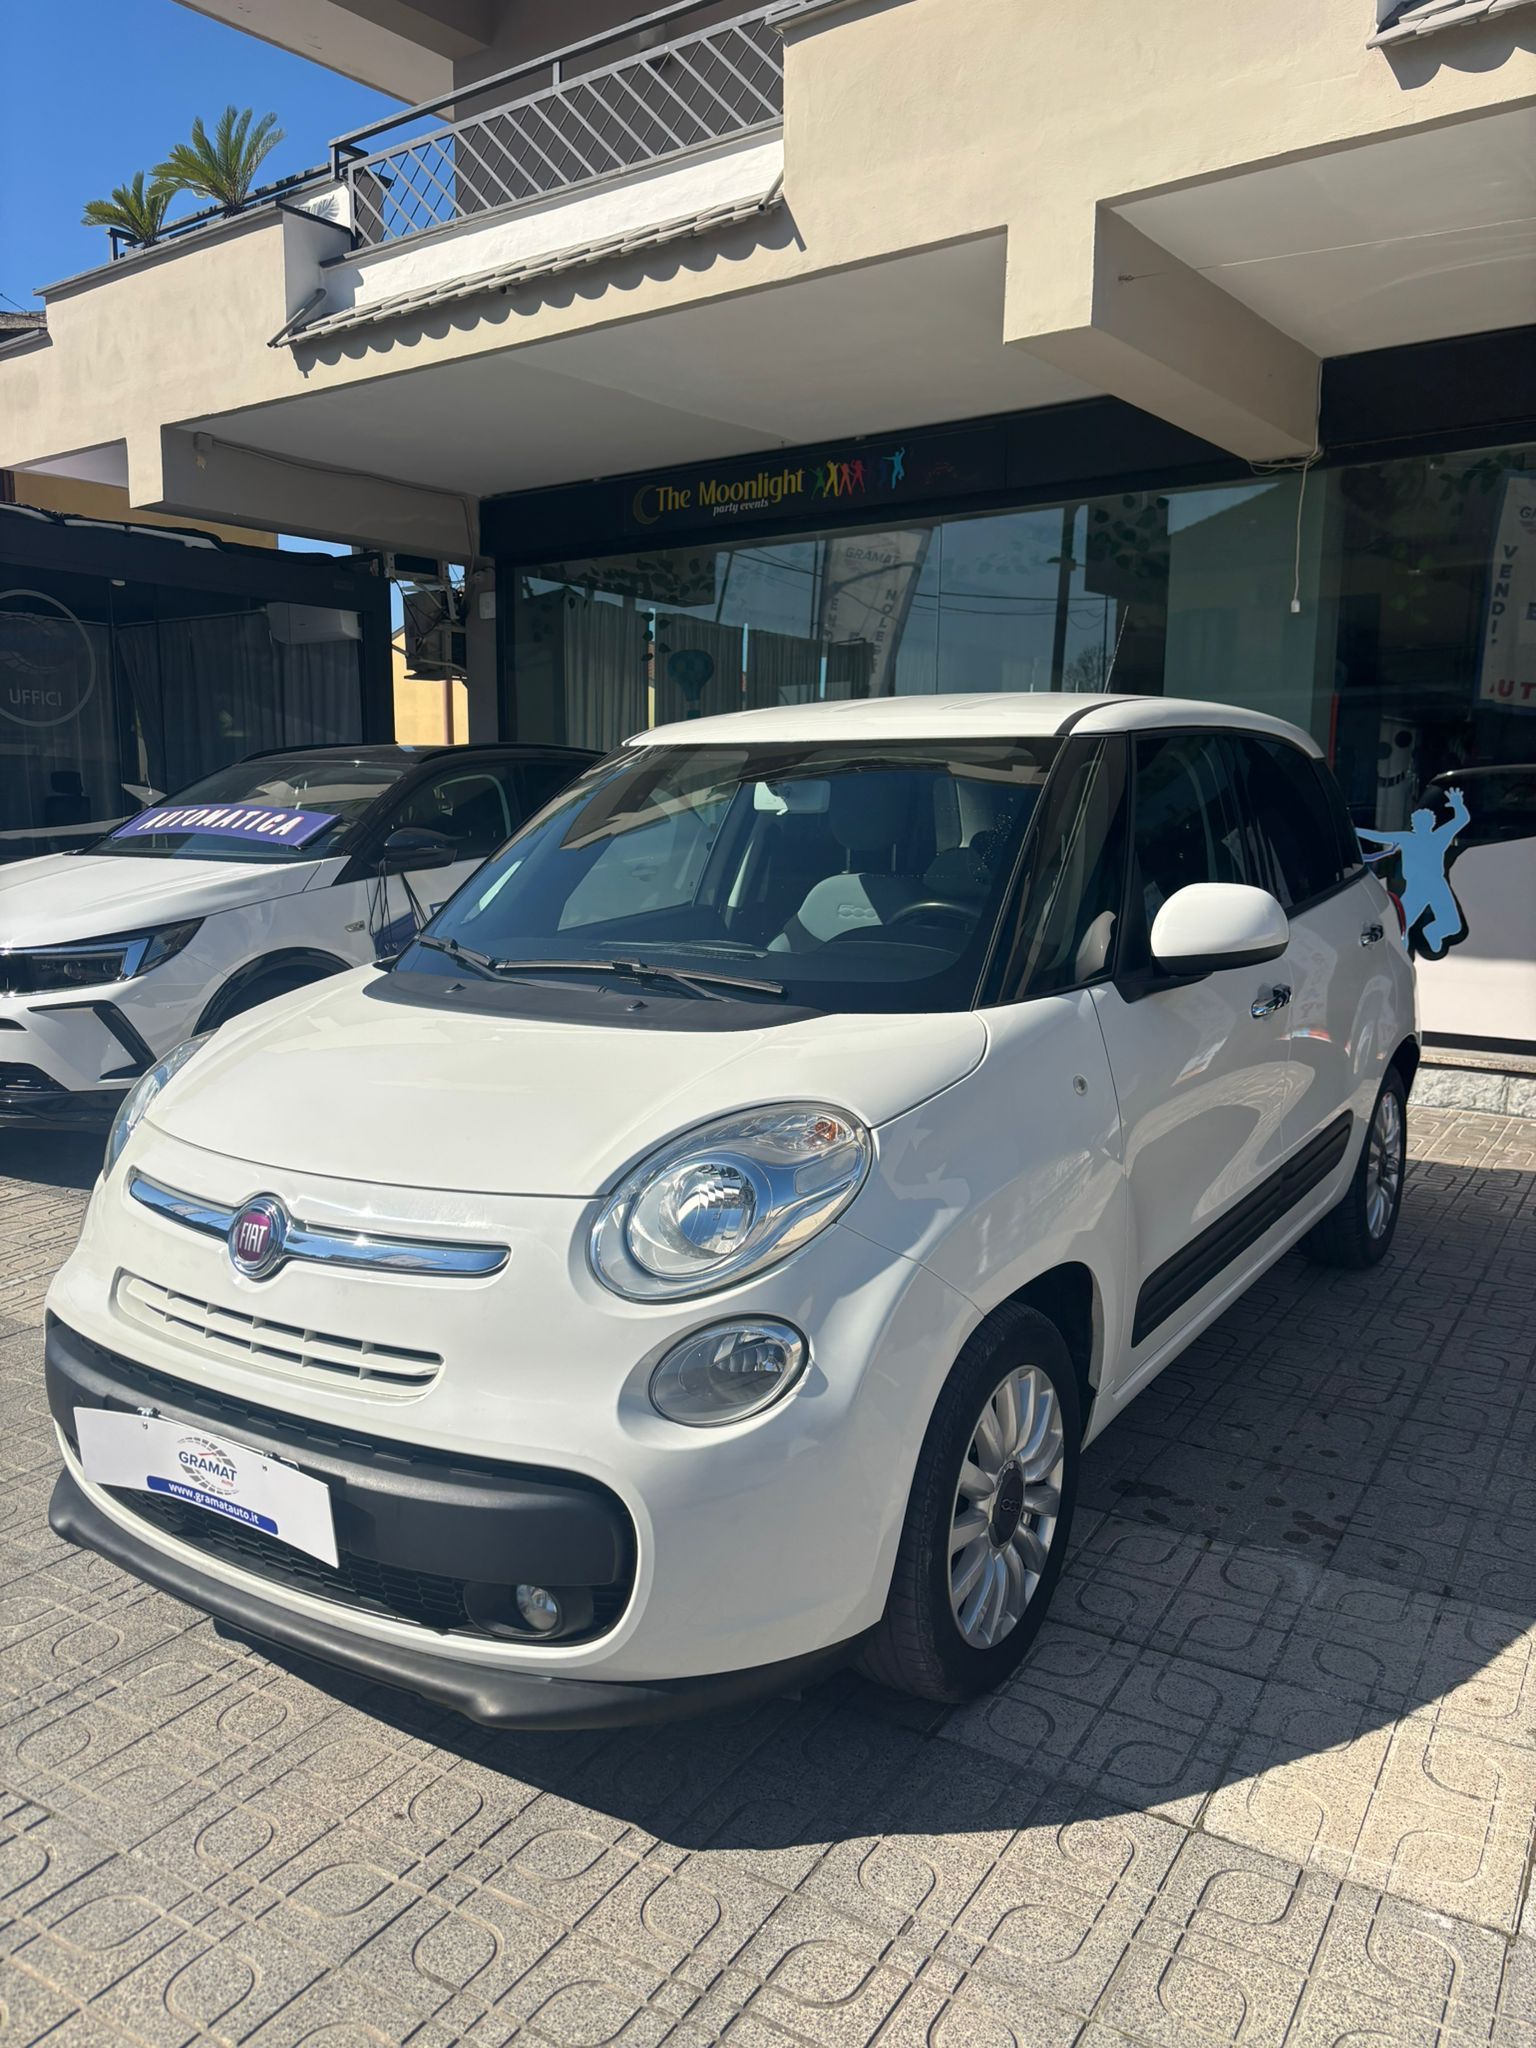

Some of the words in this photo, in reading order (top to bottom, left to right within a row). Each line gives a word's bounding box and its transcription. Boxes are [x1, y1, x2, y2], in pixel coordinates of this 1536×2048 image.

[656, 486, 691, 512] The
[699, 467, 805, 506] Moonlight
[713, 502, 738, 517] party
[740, 498, 769, 512] events
[8, 688, 62, 706] UFFICI
[136, 808, 304, 836] AUTOMATICA
[239, 1222, 268, 1254] FIAT
[178, 1451, 238, 1481] GRAMAT
[168, 1483, 260, 1525] www.gramatauto.it
